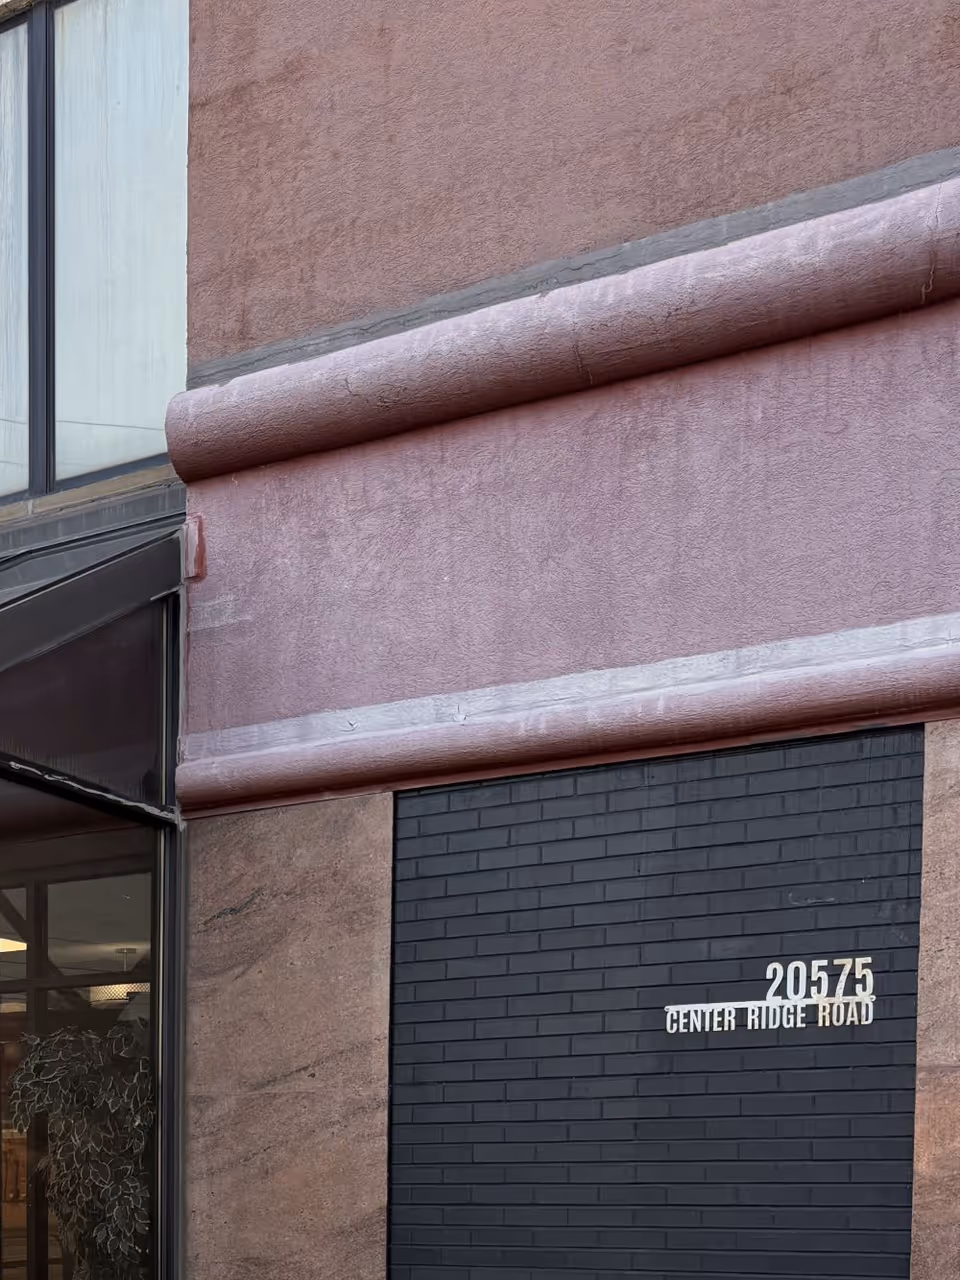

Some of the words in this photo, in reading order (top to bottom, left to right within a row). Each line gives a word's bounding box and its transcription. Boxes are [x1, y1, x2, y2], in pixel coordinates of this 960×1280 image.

[765, 956, 874, 1001] 20575
[666, 1006, 736, 1034] CENTER
[747, 1003, 807, 1030] RIDGE
[817, 1000, 874, 1027] ROAD
